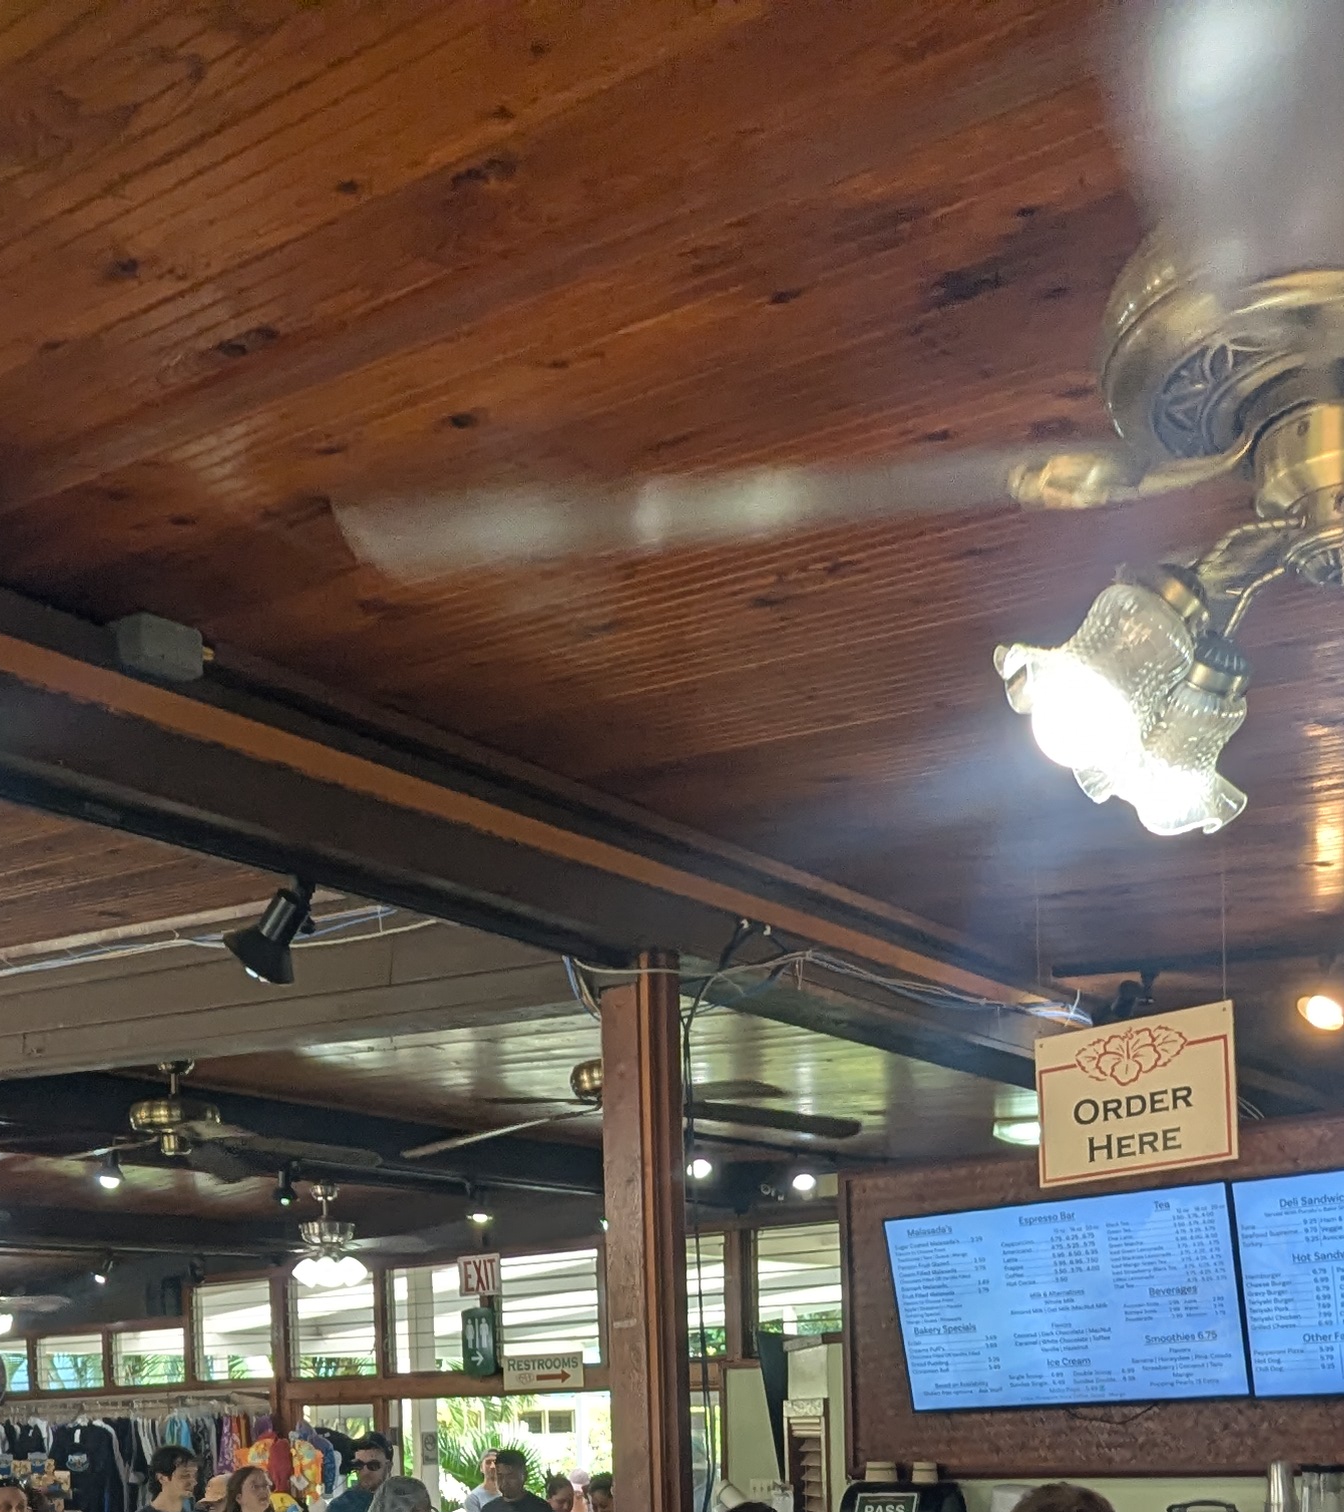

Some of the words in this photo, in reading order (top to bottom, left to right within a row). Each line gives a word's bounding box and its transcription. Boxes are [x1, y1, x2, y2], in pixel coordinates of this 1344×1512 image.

[1073, 1086, 1193, 1125] ORDER
[1088, 1127, 1182, 1163] HERE
[1154, 1200, 1171, 1209] Tea
[1279, 1197, 1298, 1208] Deli
[1018, 1214, 1058, 1226] Espresso
[1059, 1211, 1075, 1220] Bar
[1292, 1252, 1311, 1263] Hot
[462, 1258, 496, 1292] EXIT
[1148, 1285, 1198, 1296] Beverages
[914, 1327, 941, 1336] Bakery
[942, 1322, 977, 1333] Specials
[1145, 1333, 1196, 1344] Smoothies
[1197, 1330, 1217, 1340] 6.75
[1302, 1332, 1331, 1343] Other
[507, 1357, 579, 1371] RESTROOMS
[1047, 1358, 1060, 1367] Ice
[1061, 1357, 1091, 1366] Cream
